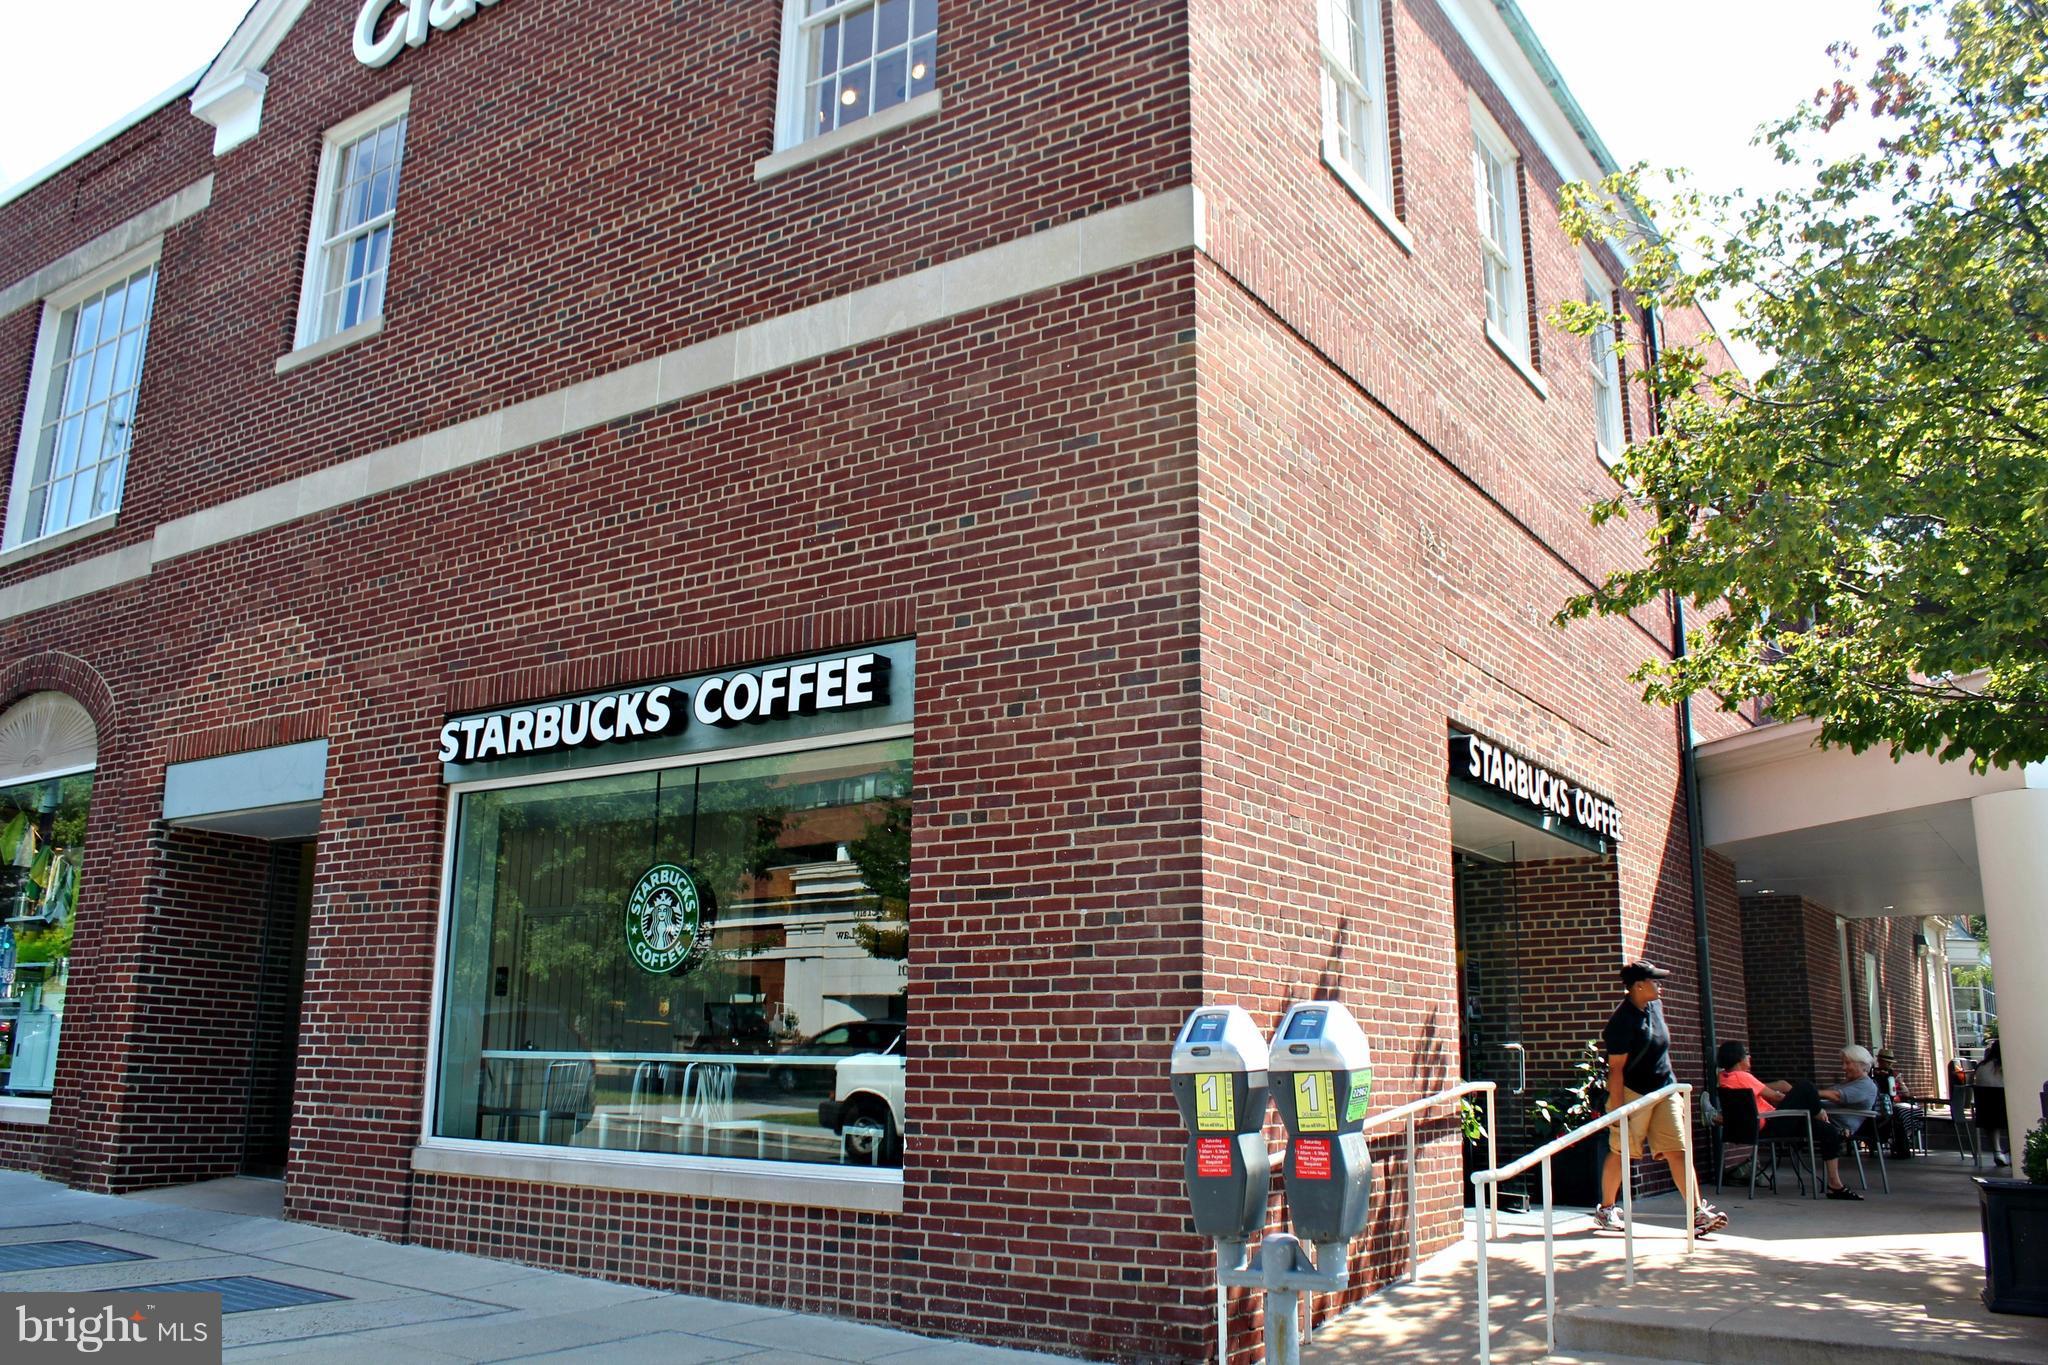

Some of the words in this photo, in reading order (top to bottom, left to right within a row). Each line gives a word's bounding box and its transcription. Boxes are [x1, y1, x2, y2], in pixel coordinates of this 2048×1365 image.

[437, 685, 672, 763] STARBUCKS
[693, 653, 876, 725] COFFEE
[1468, 733, 1570, 818] STARBUCKS
[1575, 787, 1624, 842] COFFEE
[631, 869, 696, 916] STARBUCKS
[635, 941, 685, 968] COFFEE
[1202, 1075, 1218, 1111] 1
[1301, 1074, 1319, 1111] 1
